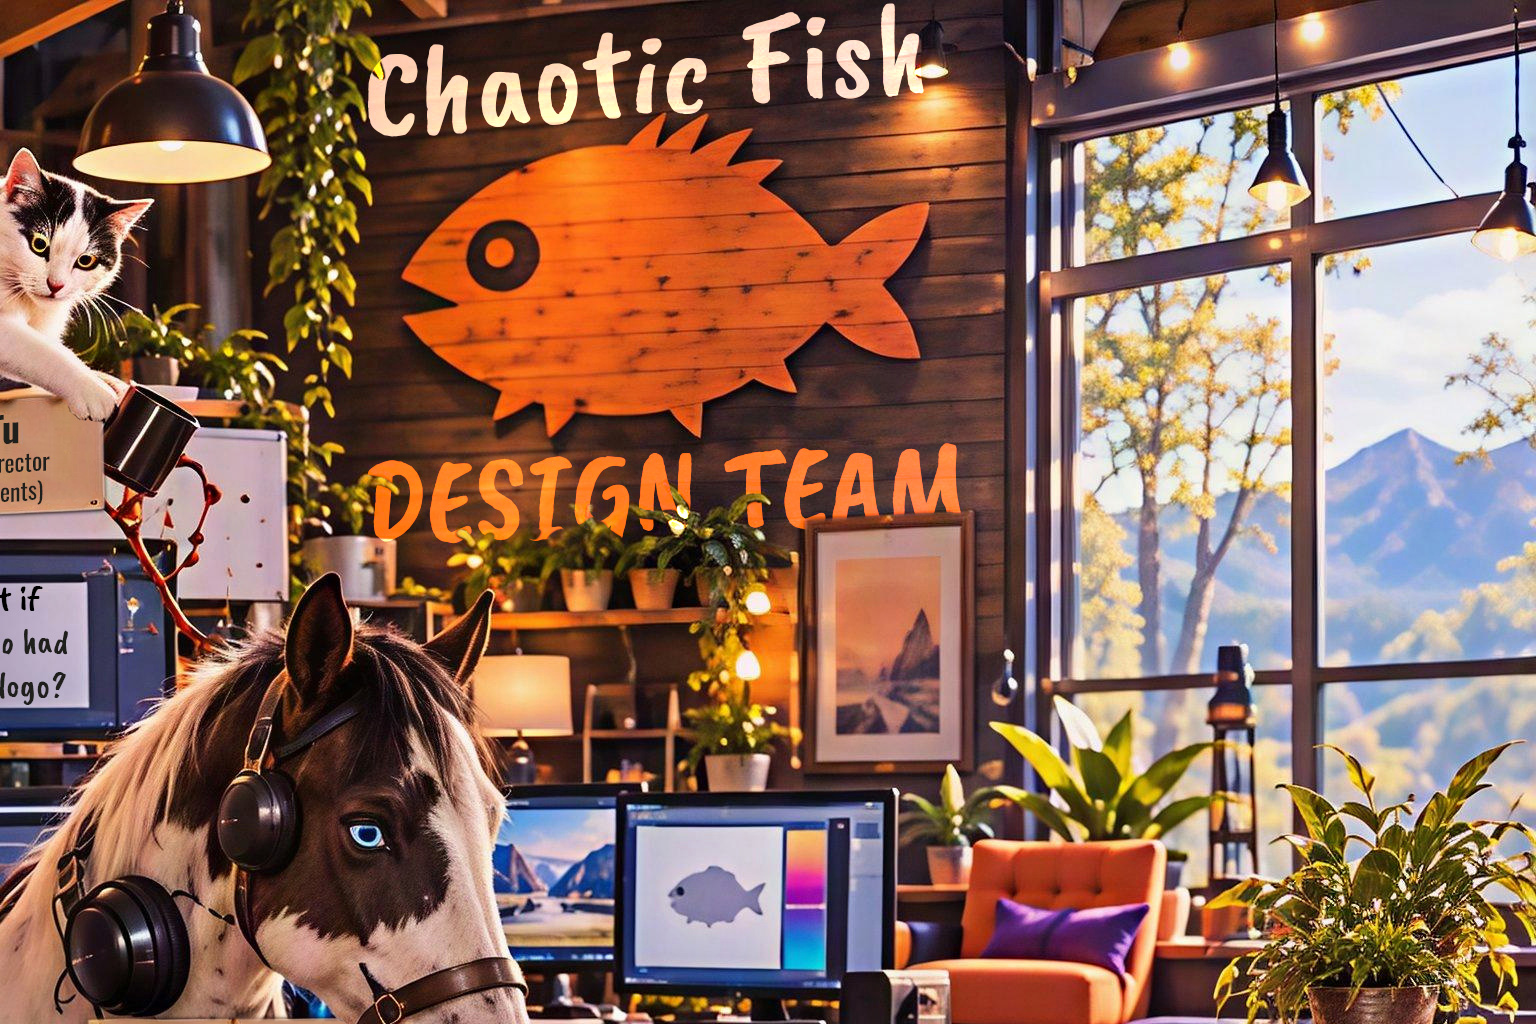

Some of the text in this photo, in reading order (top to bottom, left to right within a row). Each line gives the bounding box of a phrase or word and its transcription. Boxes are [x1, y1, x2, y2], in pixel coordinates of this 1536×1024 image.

[368, 3, 924, 137] Chaotic Fish
[368, 443, 962, 543] DESIGN TEAM
[21, 585, 43, 611] if
[23, 629, 69, 654] had
[0, 671, 66, 705] logo?
